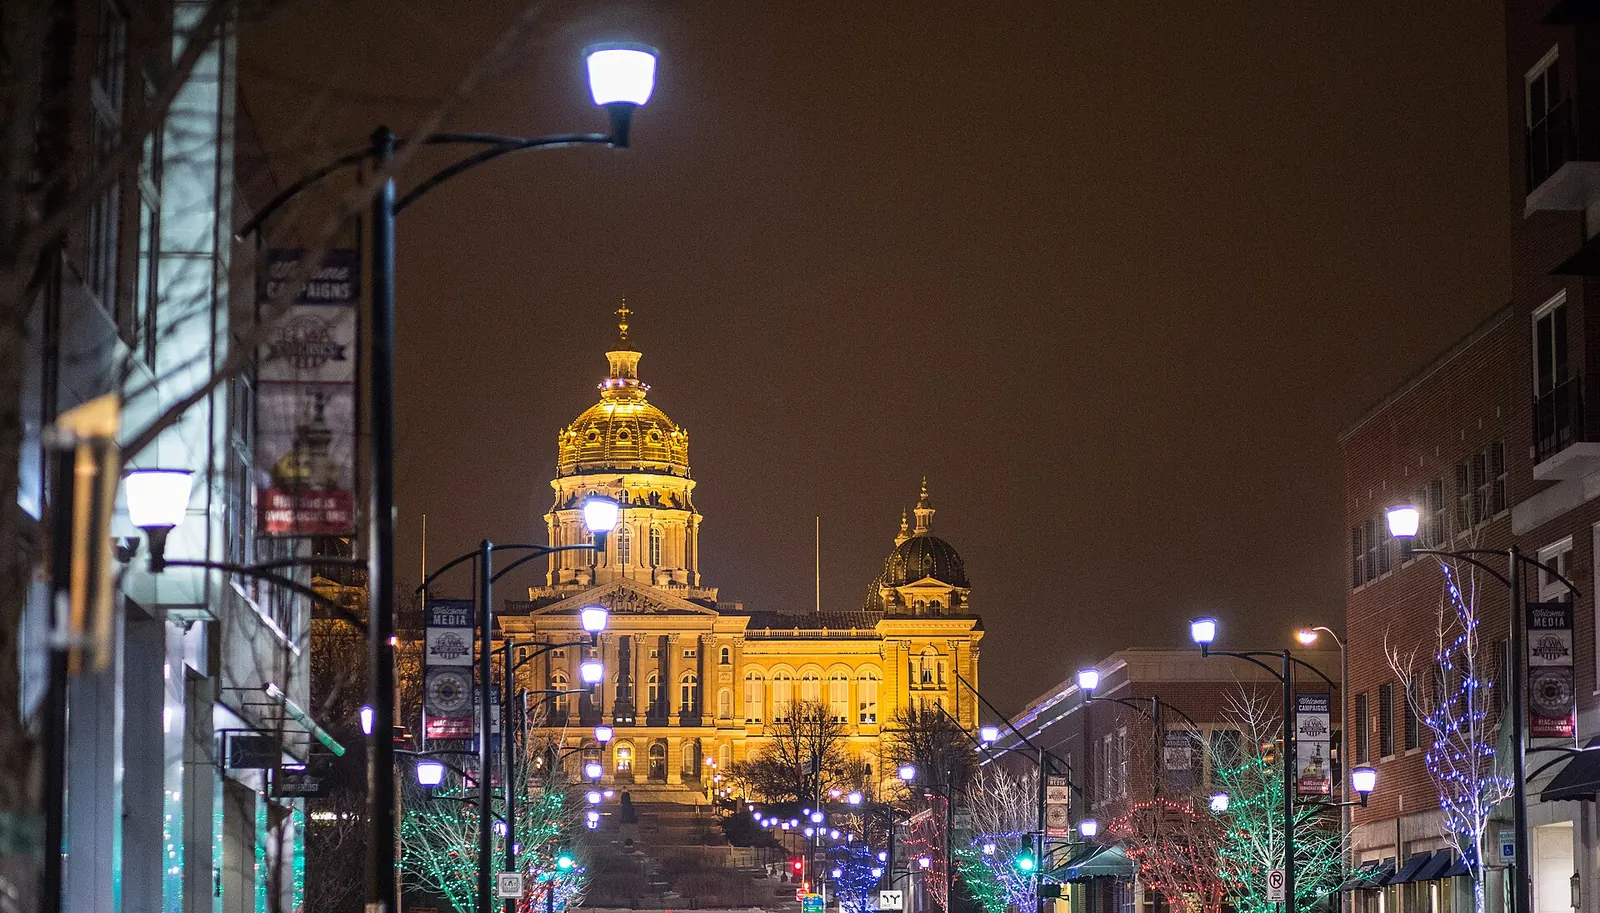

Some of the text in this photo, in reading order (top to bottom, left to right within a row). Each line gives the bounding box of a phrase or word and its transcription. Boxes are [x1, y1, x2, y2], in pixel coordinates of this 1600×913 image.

[266, 281, 351, 299] CPAIGNS
[432, 606, 467, 614] Welcome
[1532, 608, 1565, 617] Welcome
[433, 615, 467, 625] MEDIA
[1533, 617, 1565, 627] MEDIA
[1299, 697, 1327, 705] Welcome
[1298, 704, 1328, 712] CAMPAIGNS
